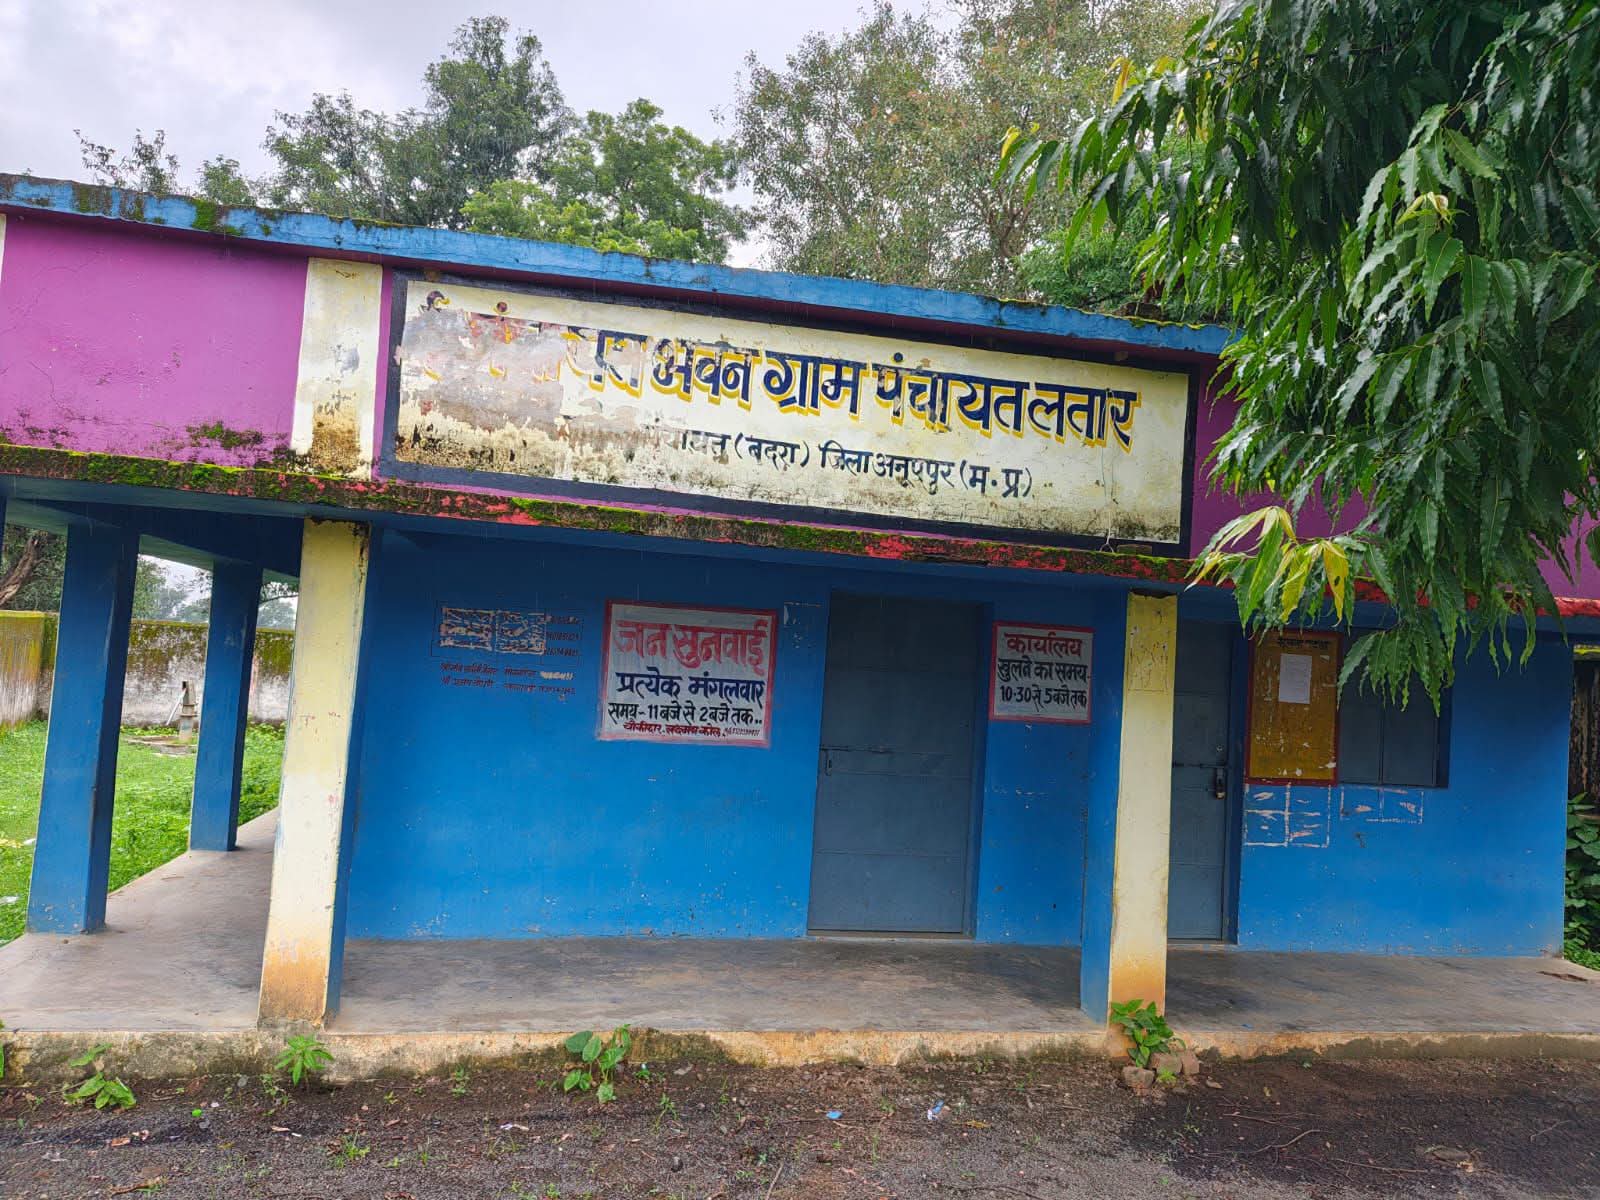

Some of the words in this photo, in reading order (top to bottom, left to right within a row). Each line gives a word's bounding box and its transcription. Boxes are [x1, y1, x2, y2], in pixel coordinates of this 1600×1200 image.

[758, 350, 870, 421] ग्राम
[870, 352, 1031, 440] पंचायत
[1027, 382, 1142, 454] लतार
[818, 440, 873, 475] जिला
[614, 619, 671, 660] जन
[672, 618, 769, 677] सुनवाई
[1004, 631, 1083, 658] कार्यालय
[997, 655, 1033, 683] खुलने
[1034, 660, 1055, 681] का
[1055, 662, 1088, 683] समय
[615, 666, 682, 700] प्रत्येक
[688, 671, 766, 709] मंगलवार
[683, 700, 696, 725] से
